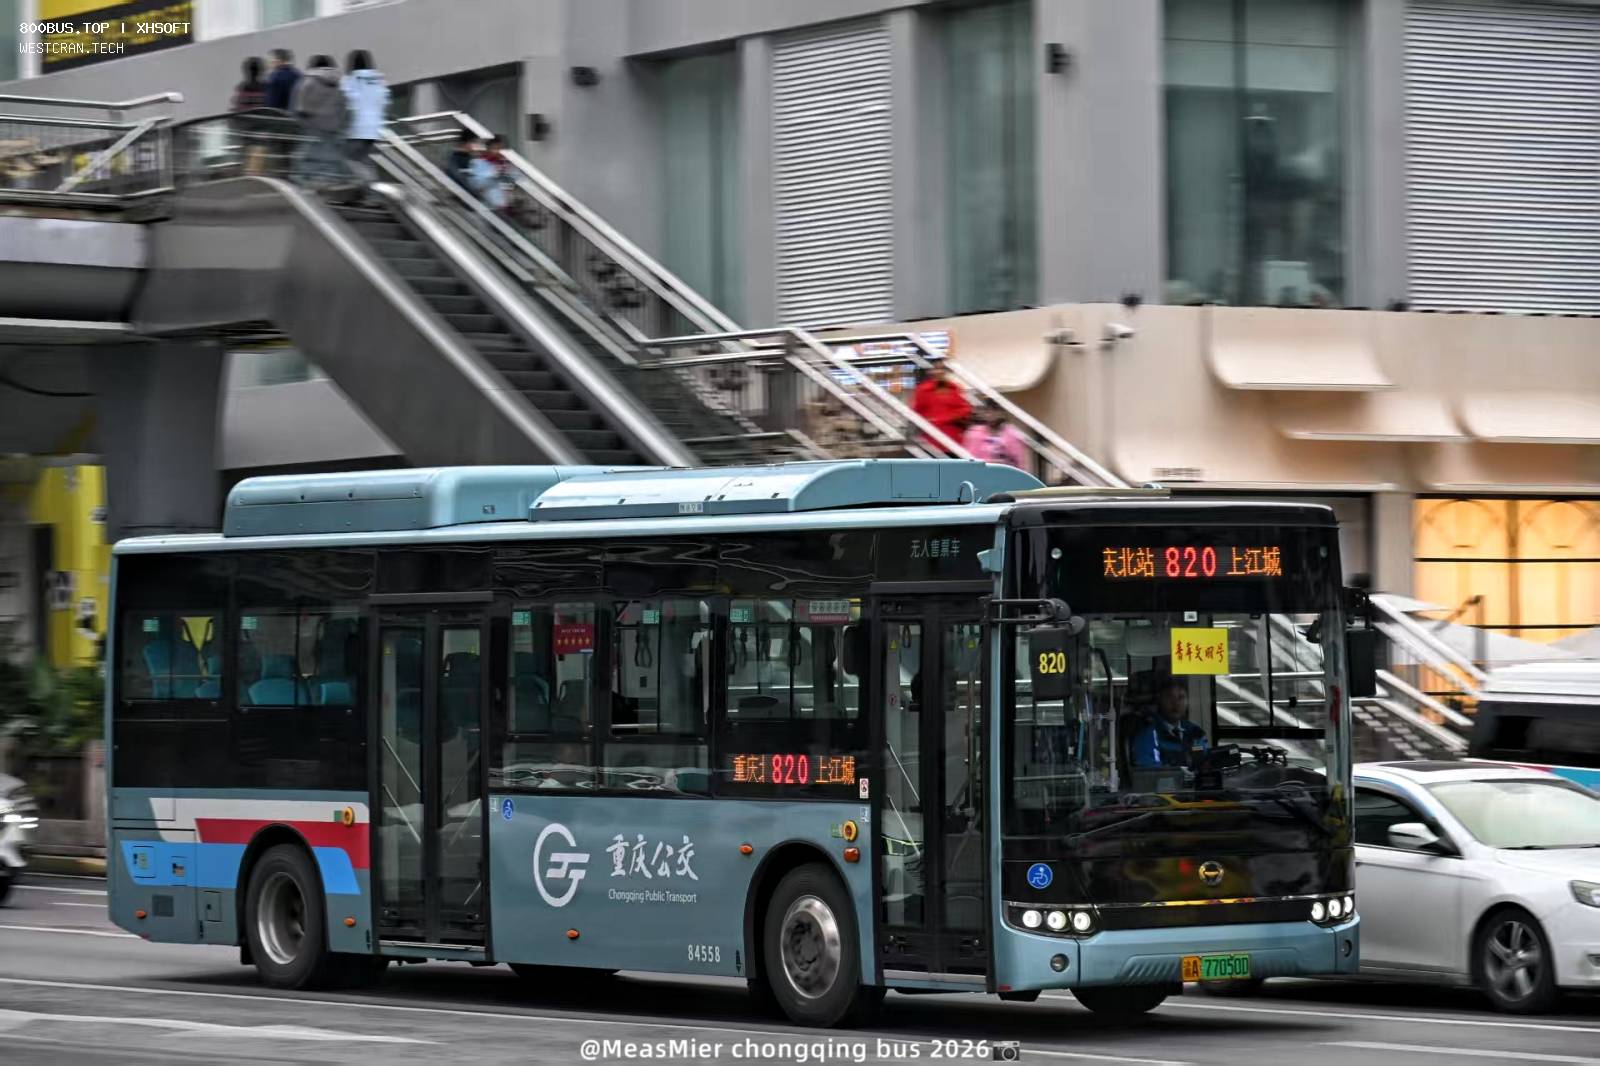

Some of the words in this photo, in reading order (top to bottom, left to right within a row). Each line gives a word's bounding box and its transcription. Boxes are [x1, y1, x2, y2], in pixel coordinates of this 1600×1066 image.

[910, 538, 961, 558] 无人售票车
[1165, 546, 1216, 577] 820
[1226, 546, 1282, 577] 上江城
[1039, 652, 1066, 674] 820
[772, 754, 808, 784] 820
[815, 755, 855, 785] 上江城
[606, 834, 699, 880] 重庆公交
[608, 888, 645, 904] Chongqing
[645, 890, 665, 902] Public
[665, 891, 697, 904] Transport
[688, 944, 721, 963] 84558
